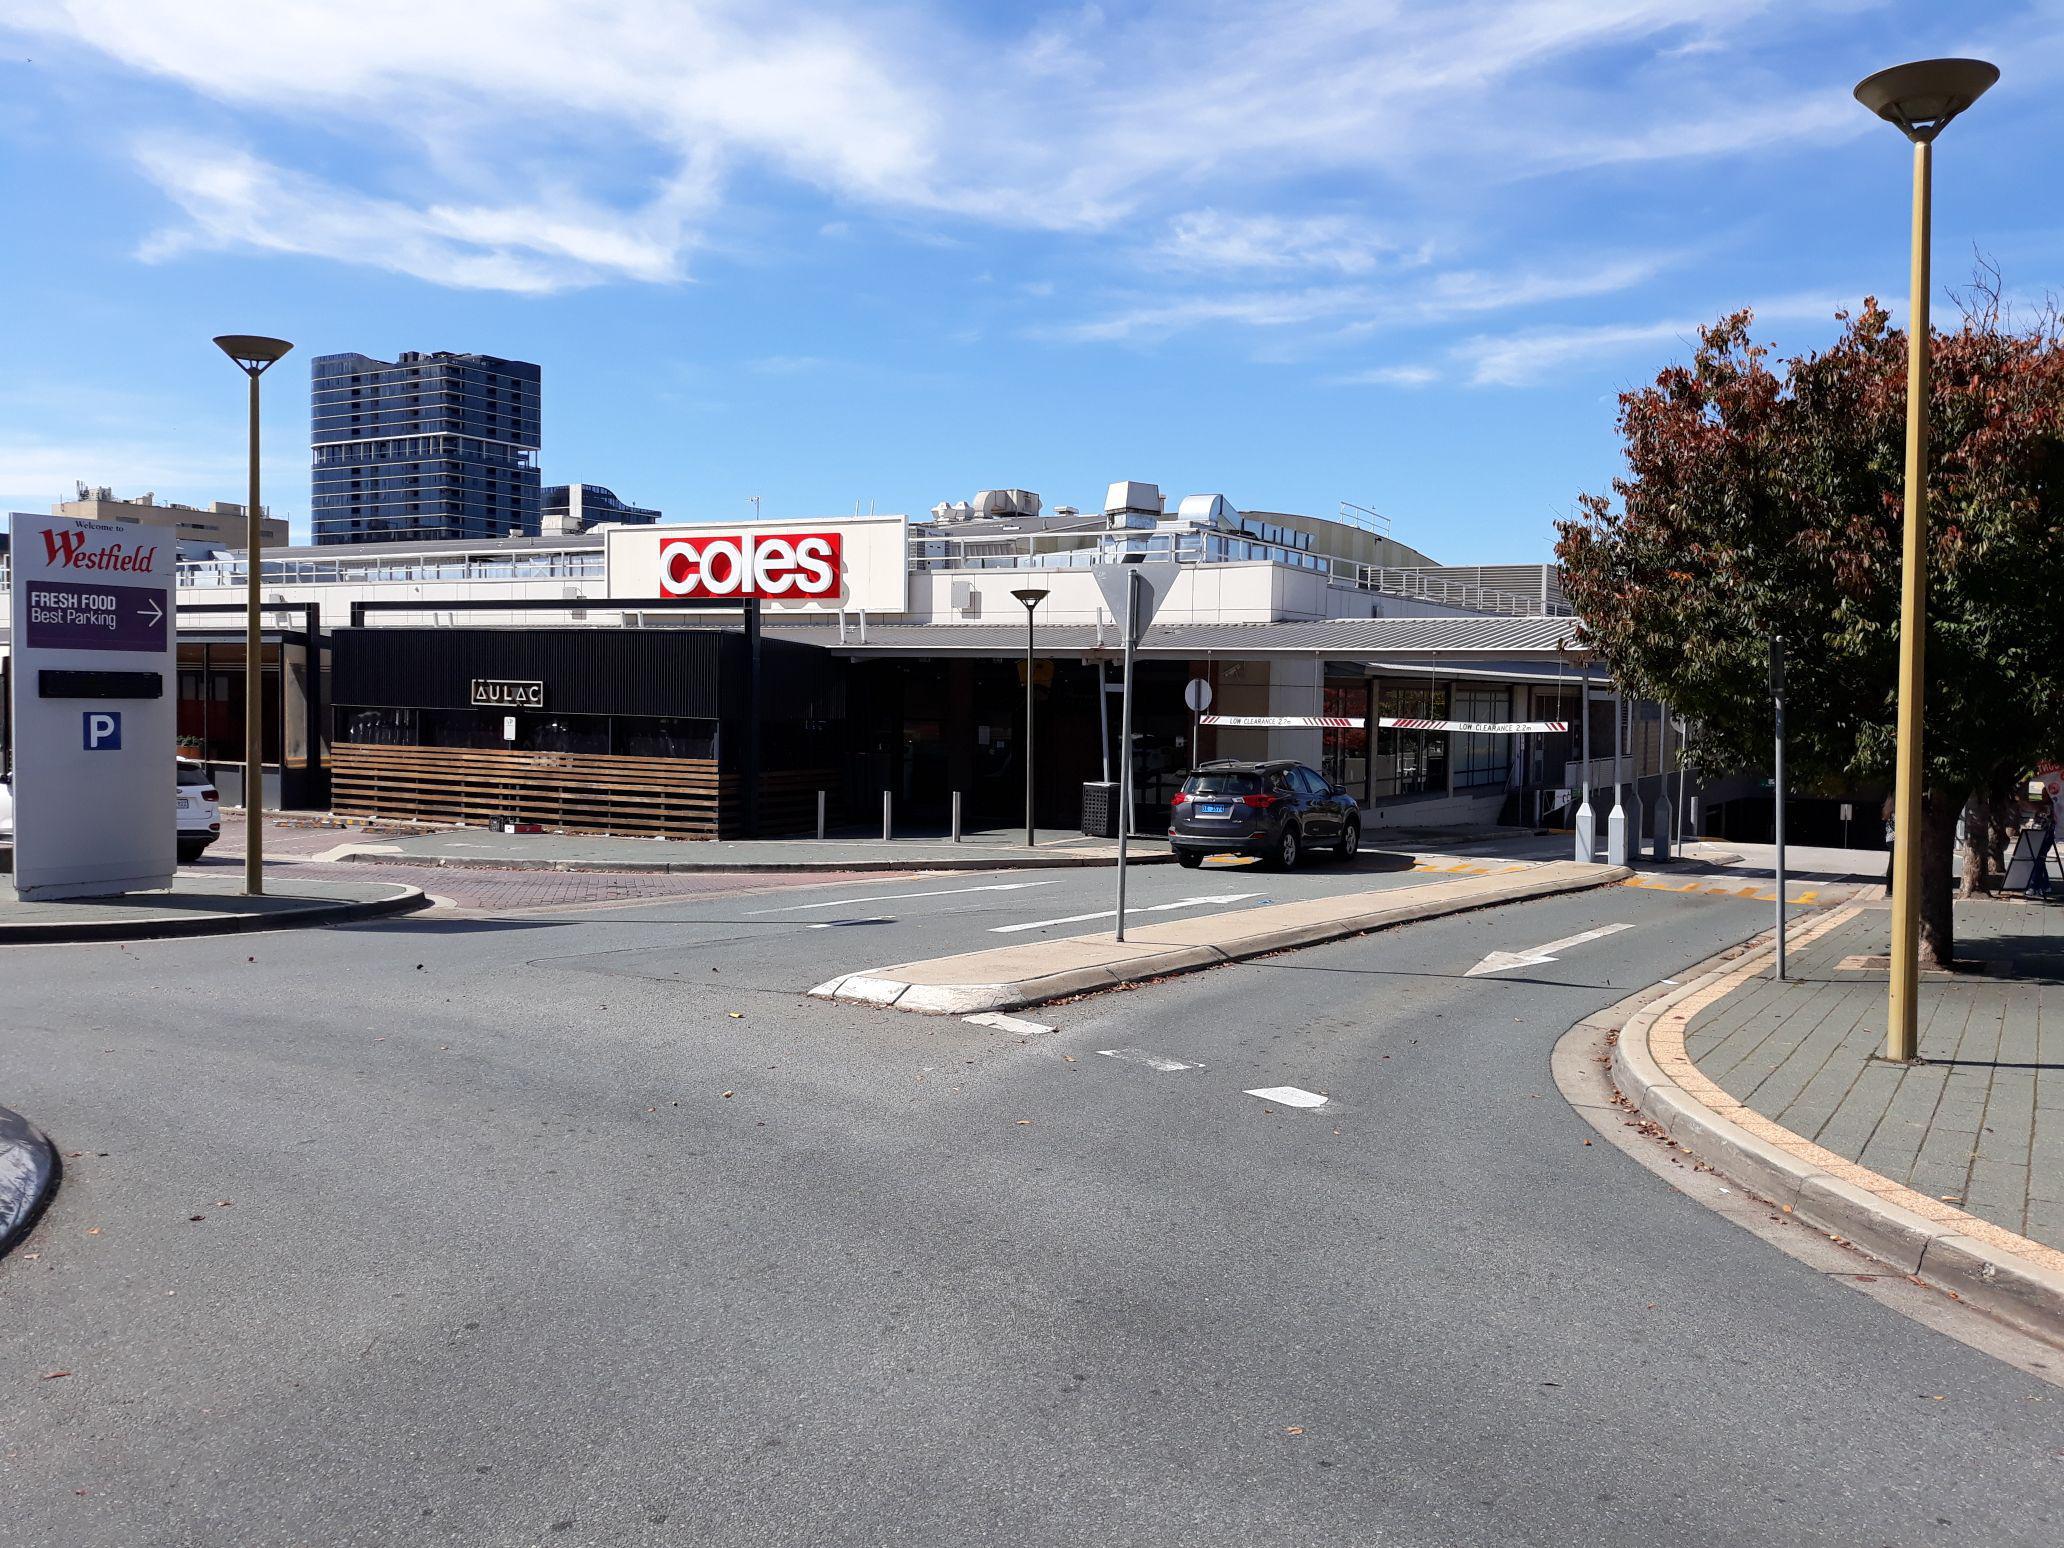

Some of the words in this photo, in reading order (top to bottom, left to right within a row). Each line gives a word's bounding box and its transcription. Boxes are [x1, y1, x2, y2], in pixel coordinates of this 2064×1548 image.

[75, 520, 114, 532] Welcome
[38, 528, 158, 573] Westfield
[660, 535, 833, 595] coles
[31, 592, 78, 608] FRESH
[81, 594, 116, 610] FOOD
[31, 607, 63, 624] Best
[66, 609, 116, 630] Parking
[476, 685, 539, 702] AULAC
[1229, 717, 1241, 725] LOW
[1459, 723, 1472, 731] LOW
[1475, 724, 1513, 732] CLEARANCE
[90, 714, 115, 748] P
